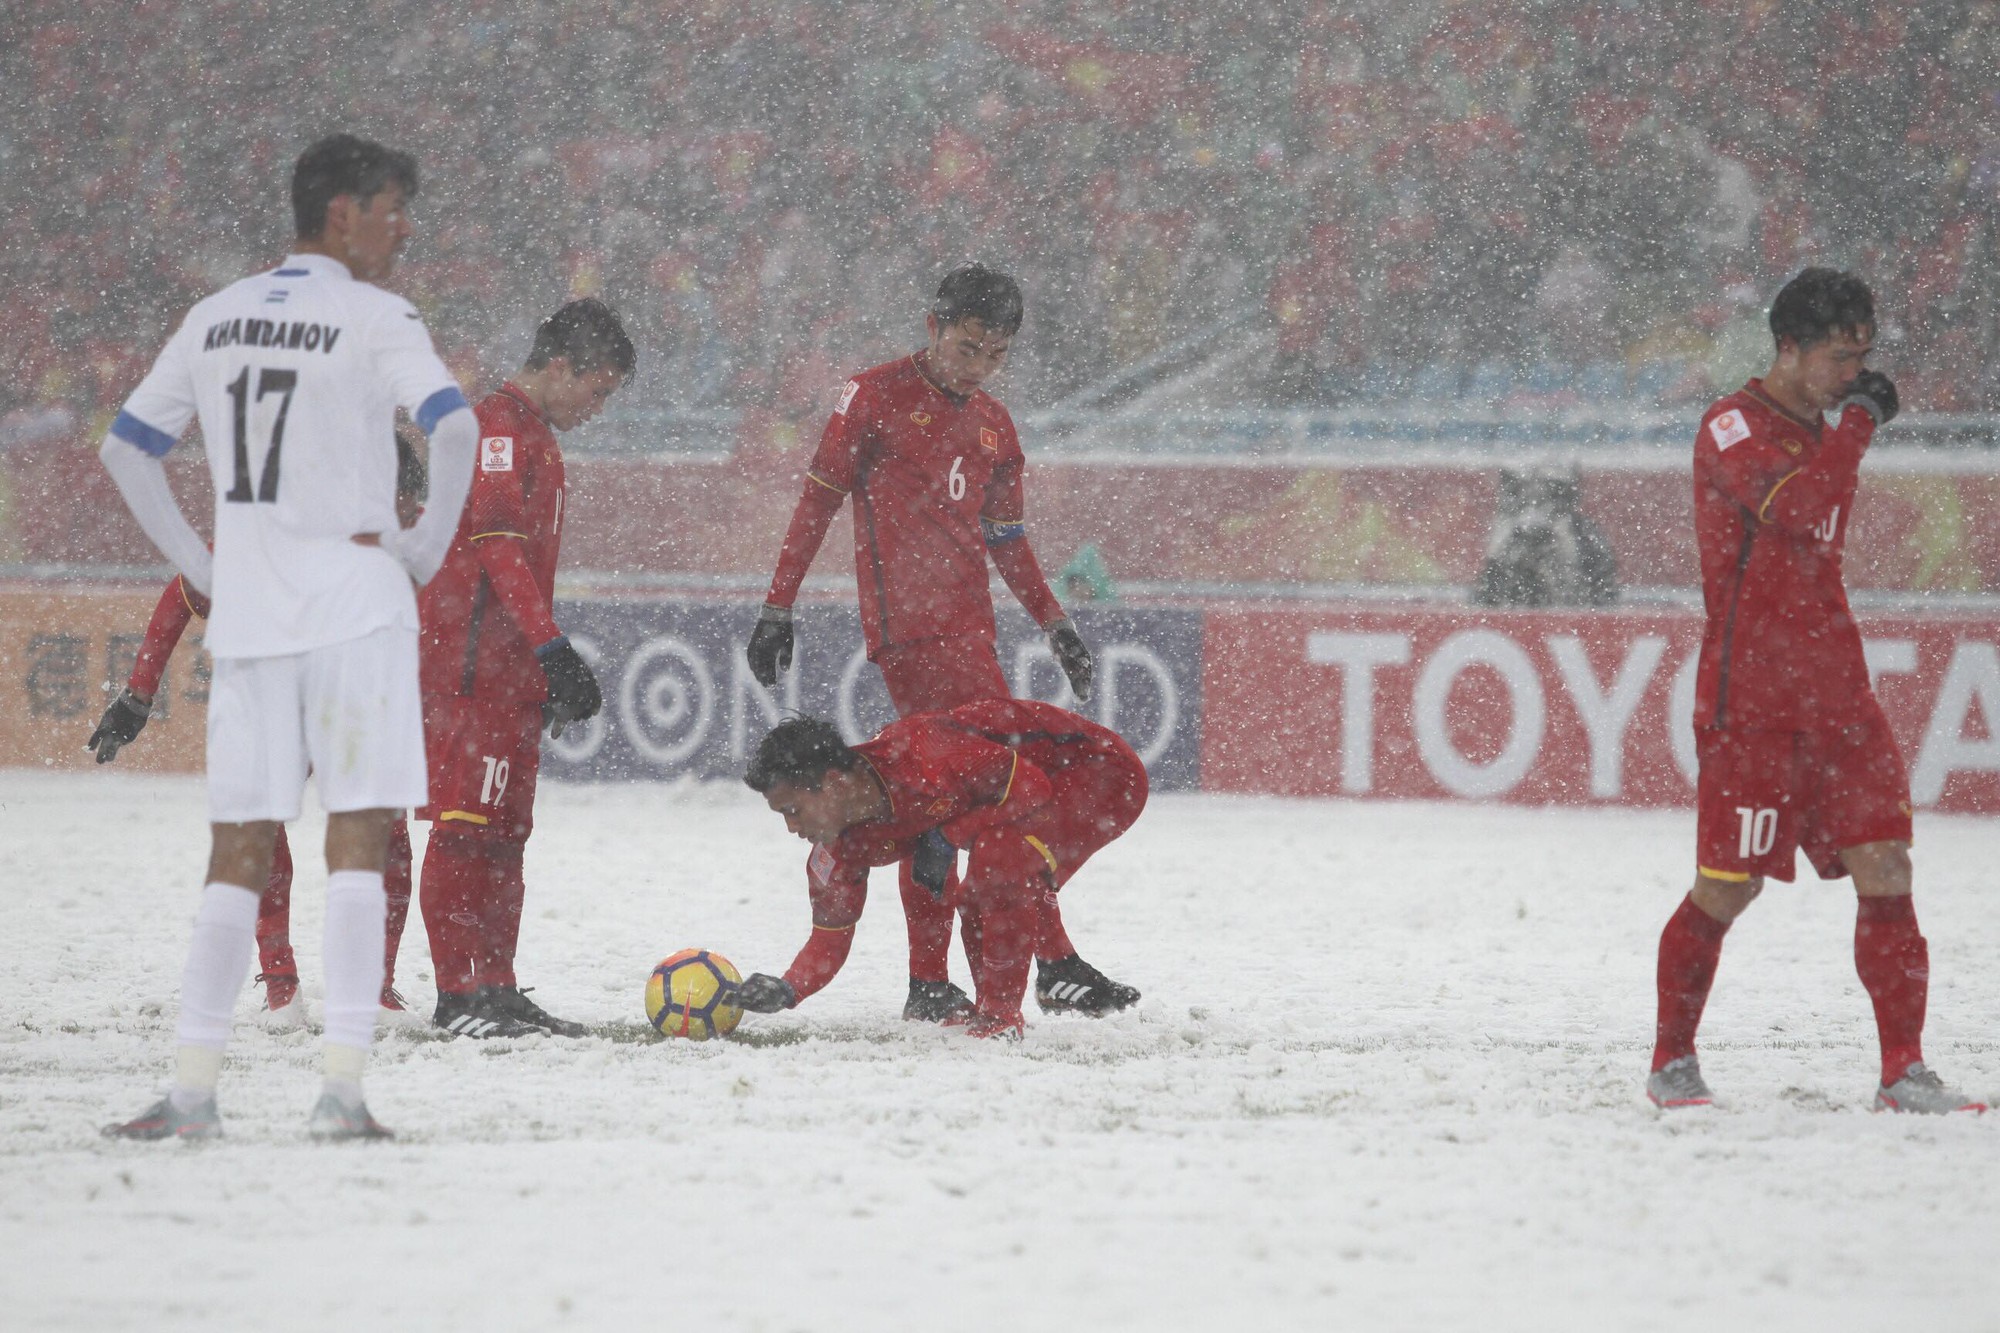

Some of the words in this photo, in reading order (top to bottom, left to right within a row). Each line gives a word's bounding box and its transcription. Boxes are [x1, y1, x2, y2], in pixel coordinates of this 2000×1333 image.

[225, 365, 297, 504] 17
[949, 456, 966, 501] 6
[1814, 505, 1841, 542] 0
[1304, 628, 2000, 806] TOYA
[480, 755, 510, 806] 19
[1736, 806, 1778, 859] 10
